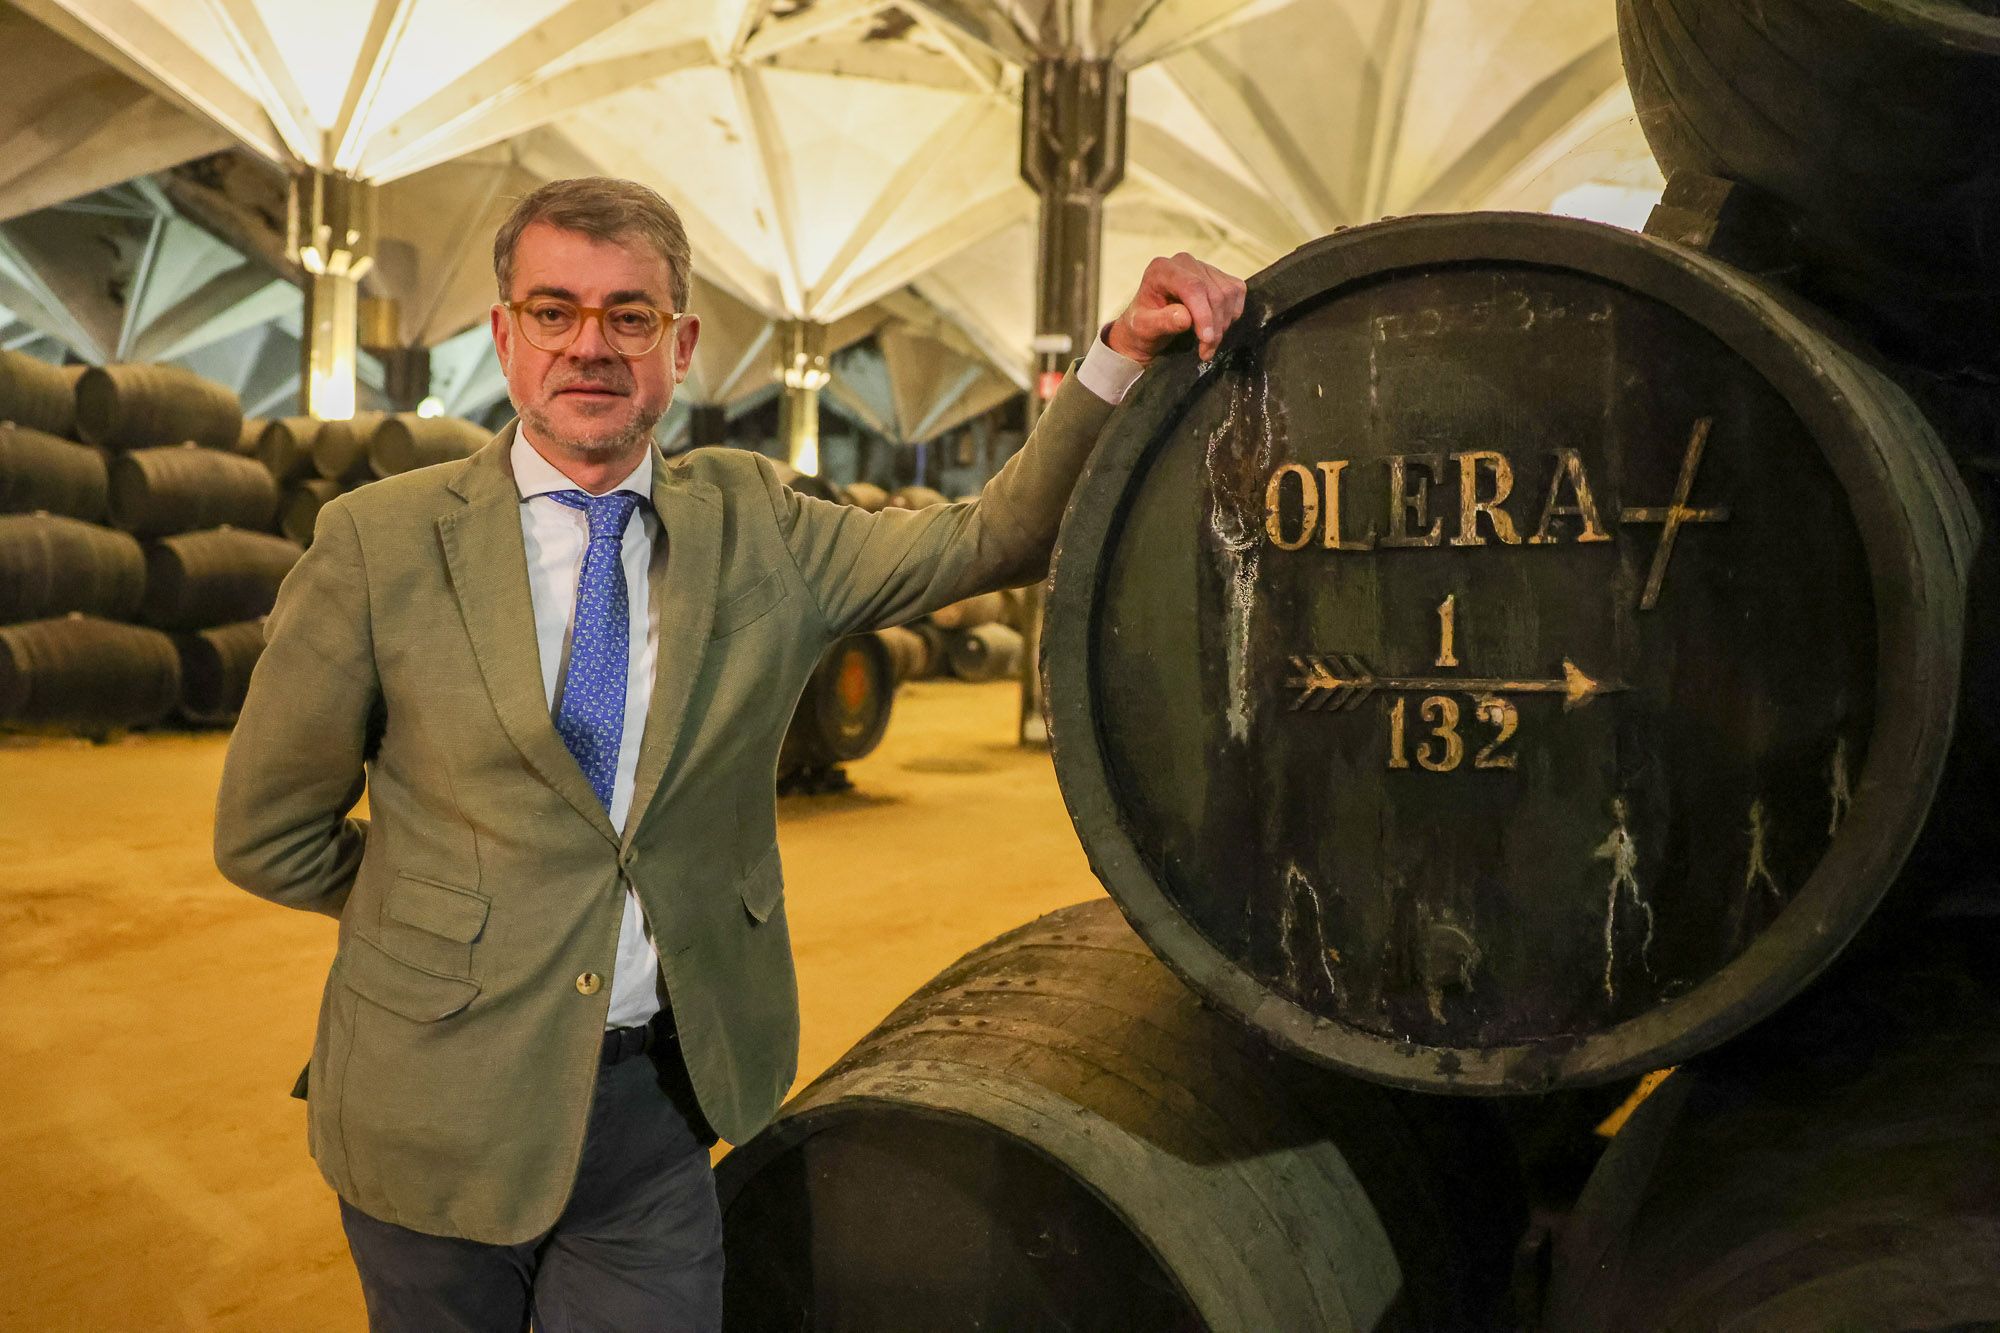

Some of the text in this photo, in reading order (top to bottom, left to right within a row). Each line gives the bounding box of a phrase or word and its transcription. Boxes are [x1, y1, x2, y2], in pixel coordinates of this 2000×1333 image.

[1265, 448, 1612, 551] OLERA
[1435, 594, 1459, 667] 1
[1388, 695, 1519, 772] 132
